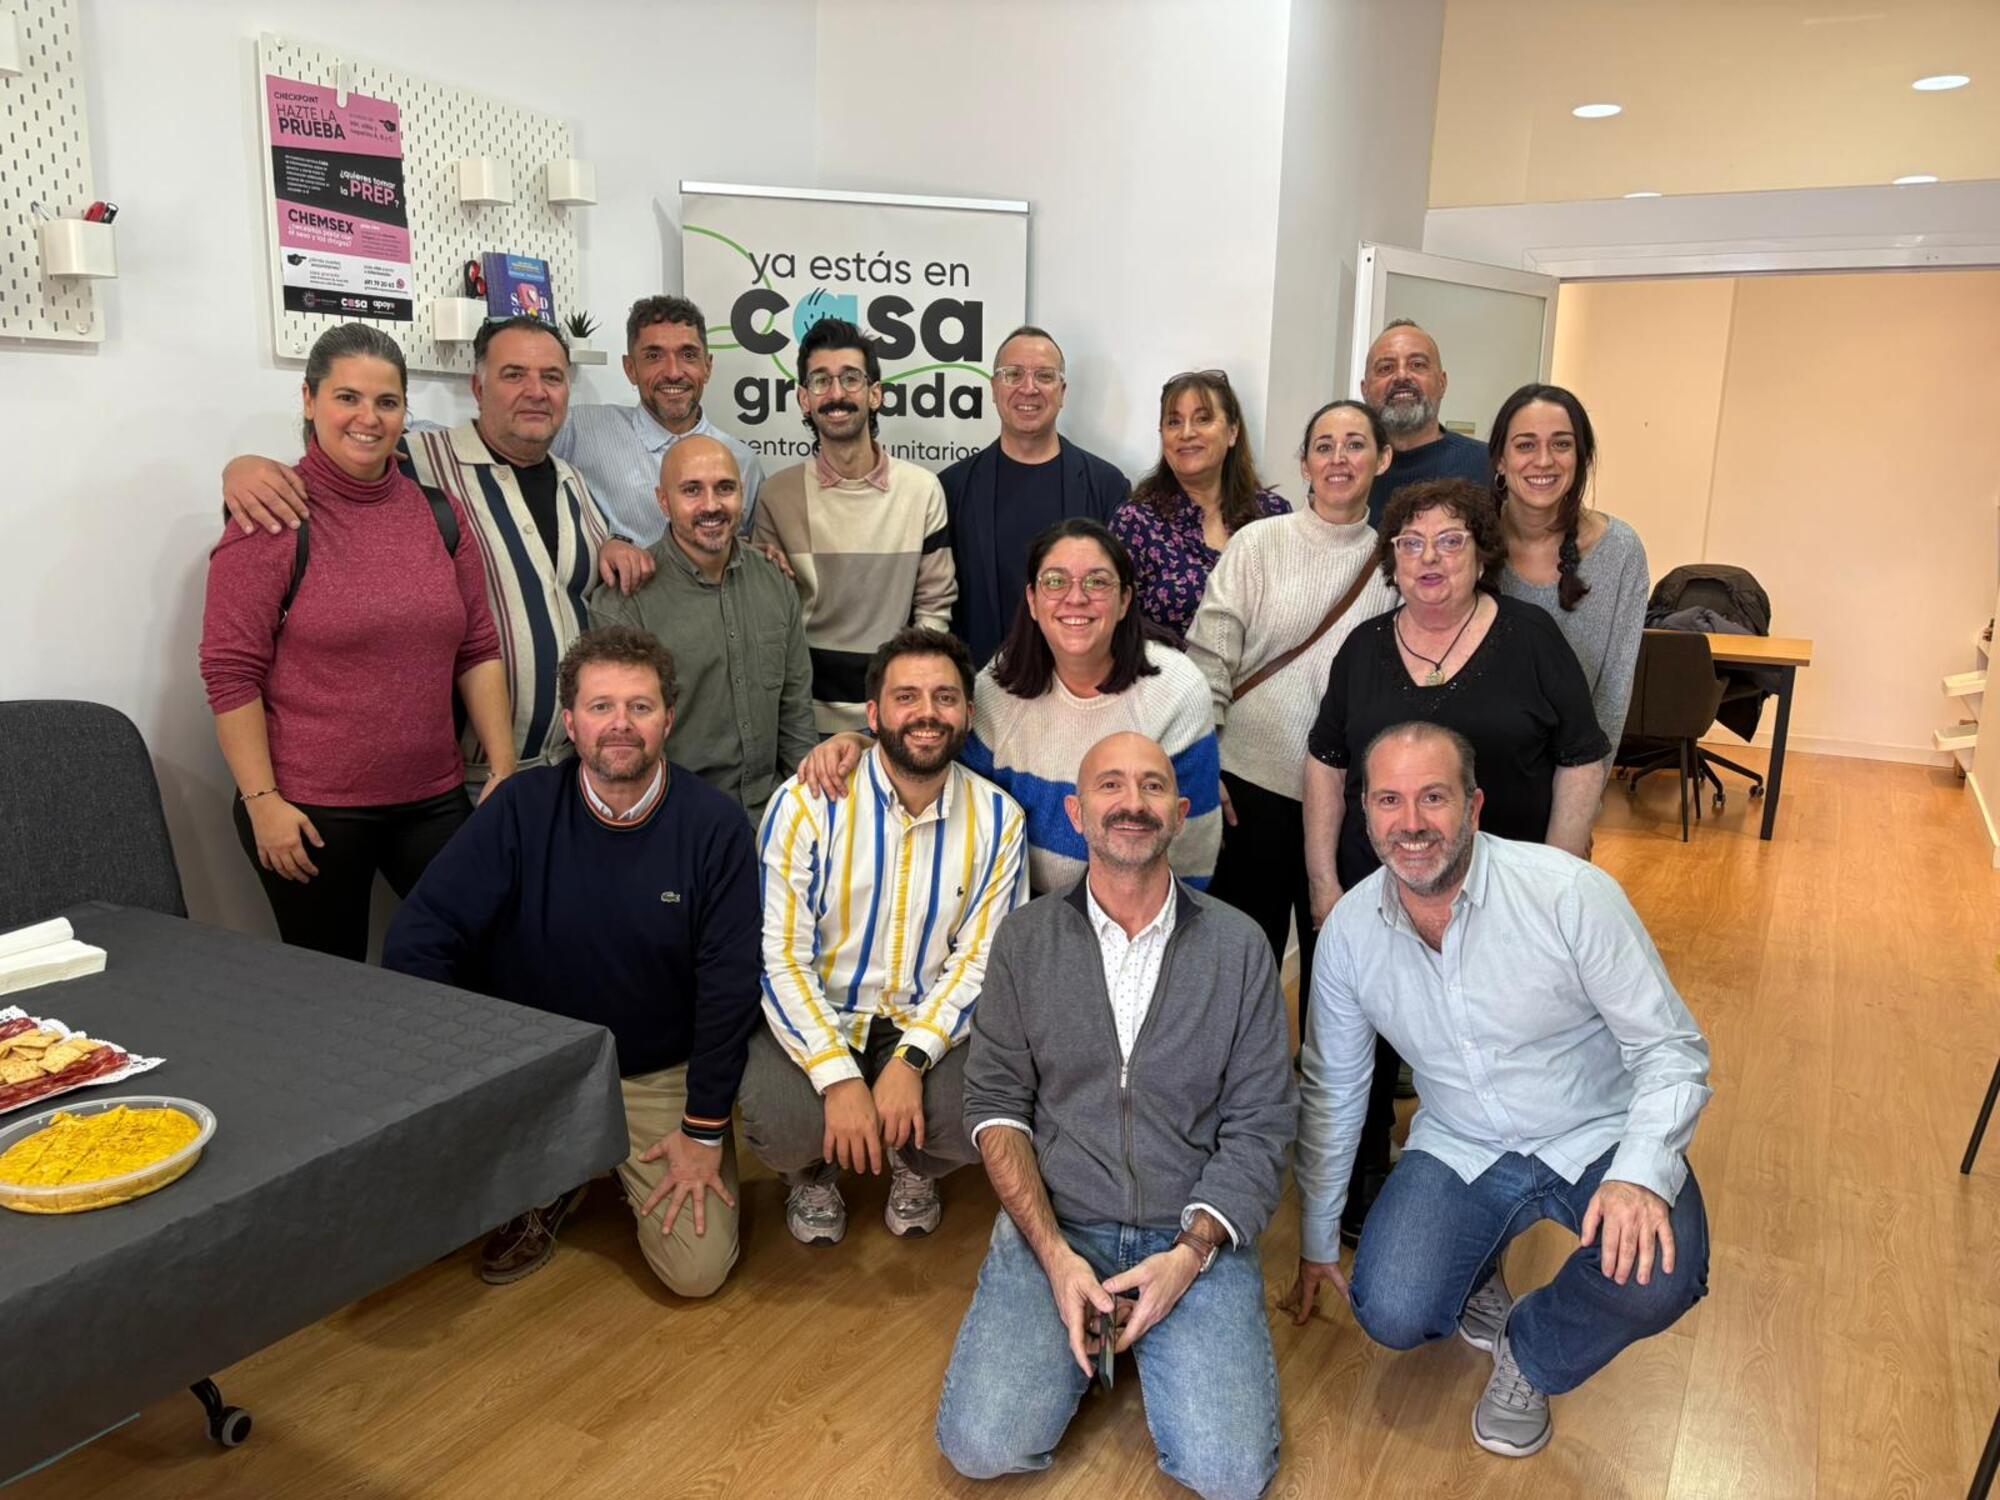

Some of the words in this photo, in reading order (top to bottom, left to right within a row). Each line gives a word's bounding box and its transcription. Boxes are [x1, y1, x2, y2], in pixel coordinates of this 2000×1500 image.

[274, 91, 319, 104] CHECKPOINT
[276, 103, 317, 121] HAZTE
[320, 108, 337, 122] LA
[278, 116, 346, 140] PRUEBA
[340, 186, 348, 196] la
[373, 177, 396, 190] tomar
[288, 208, 354, 235] CHEMSEX
[748, 252, 796, 284] ya
[810, 251, 911, 284] estás
[924, 261, 970, 287] en
[733, 372, 984, 426] grada
[740, 437, 822, 458] entro
